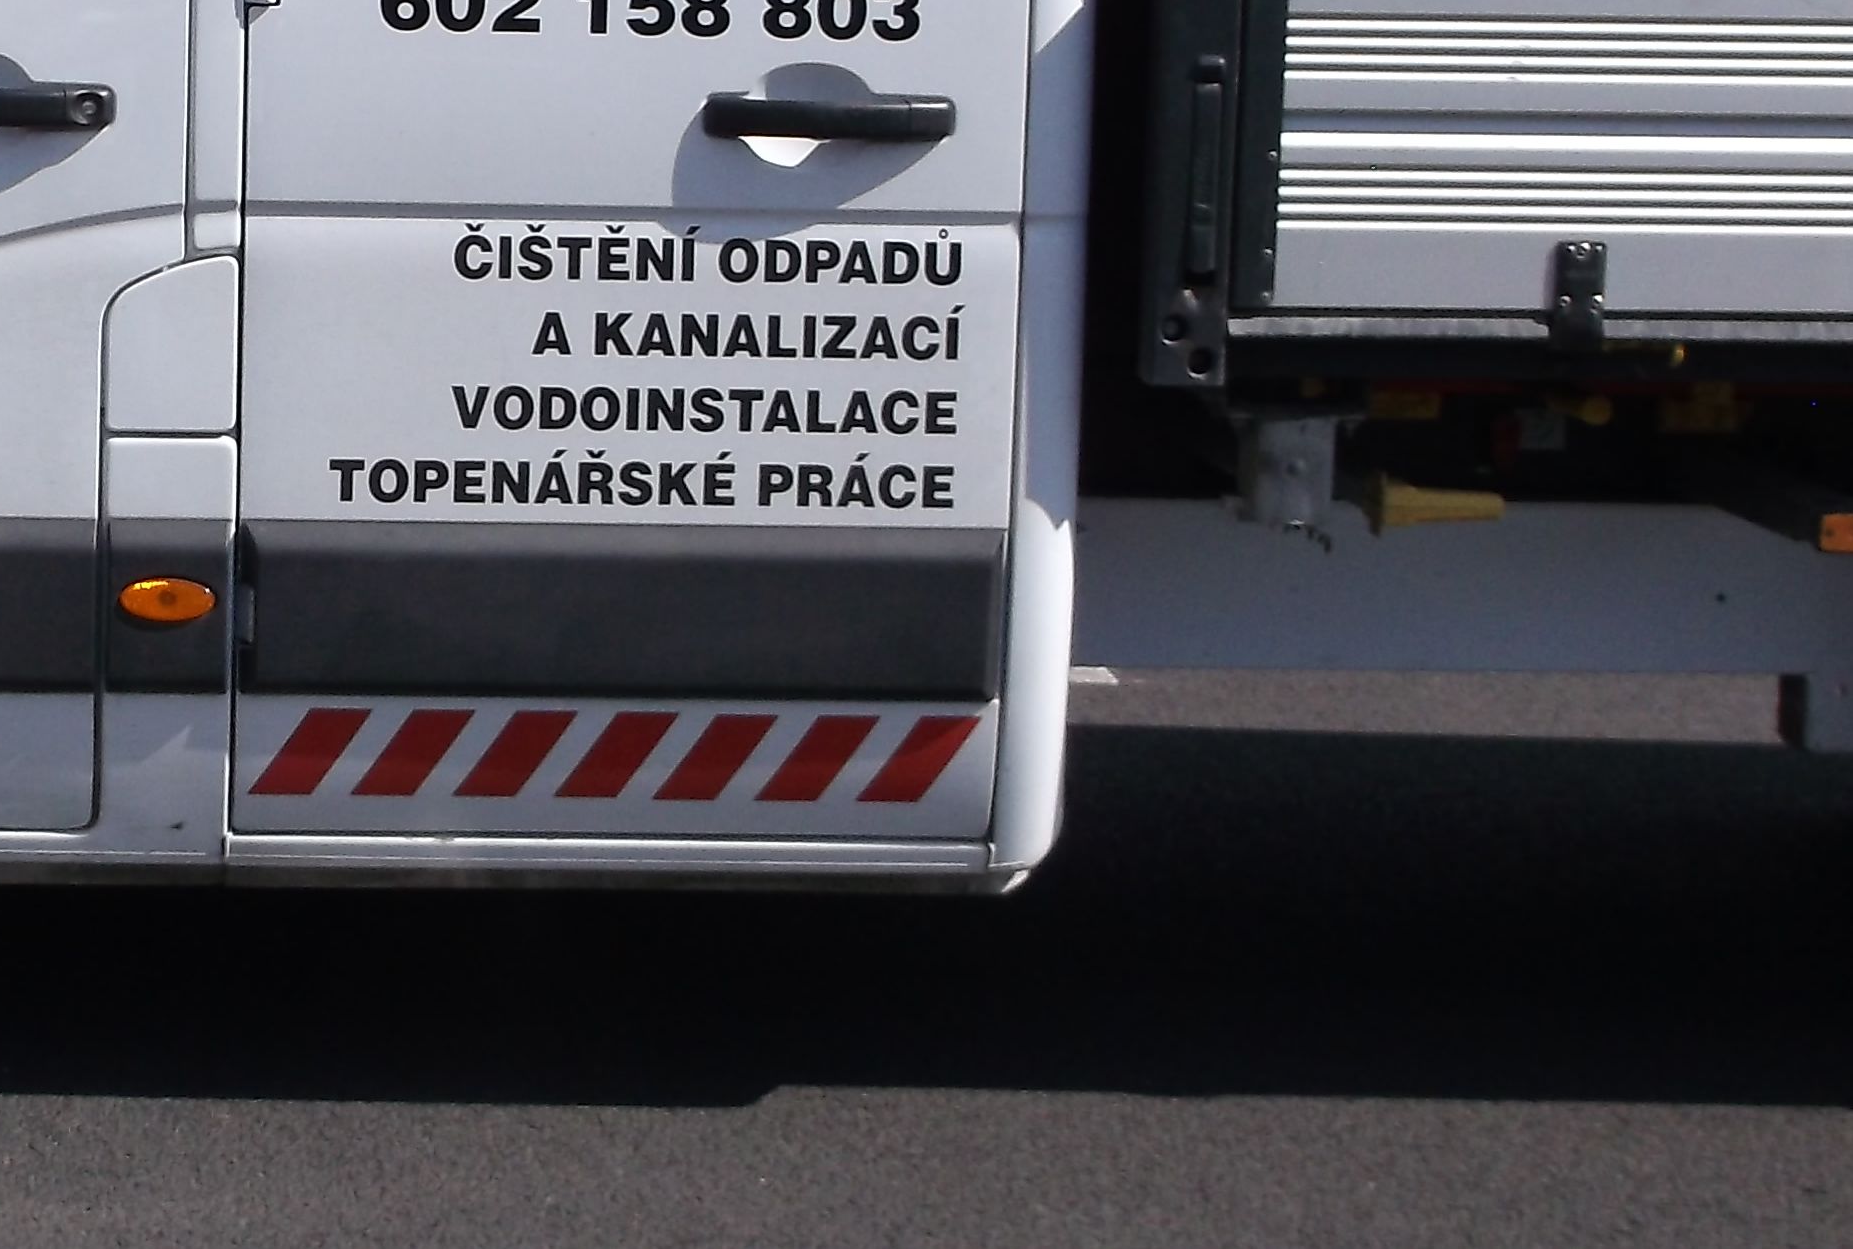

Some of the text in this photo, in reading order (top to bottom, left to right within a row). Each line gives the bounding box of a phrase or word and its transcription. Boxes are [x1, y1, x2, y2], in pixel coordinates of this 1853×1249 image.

[454, 224, 963, 285] ČIŠTĚNÍ ODPADŮ
[532, 305, 965, 361] A KANALIZACÍ
[451, 386, 958, 434] VODOINSTALACE
[330, 450, 955, 509] TOPENÁŘSKÉ PRÁCE
